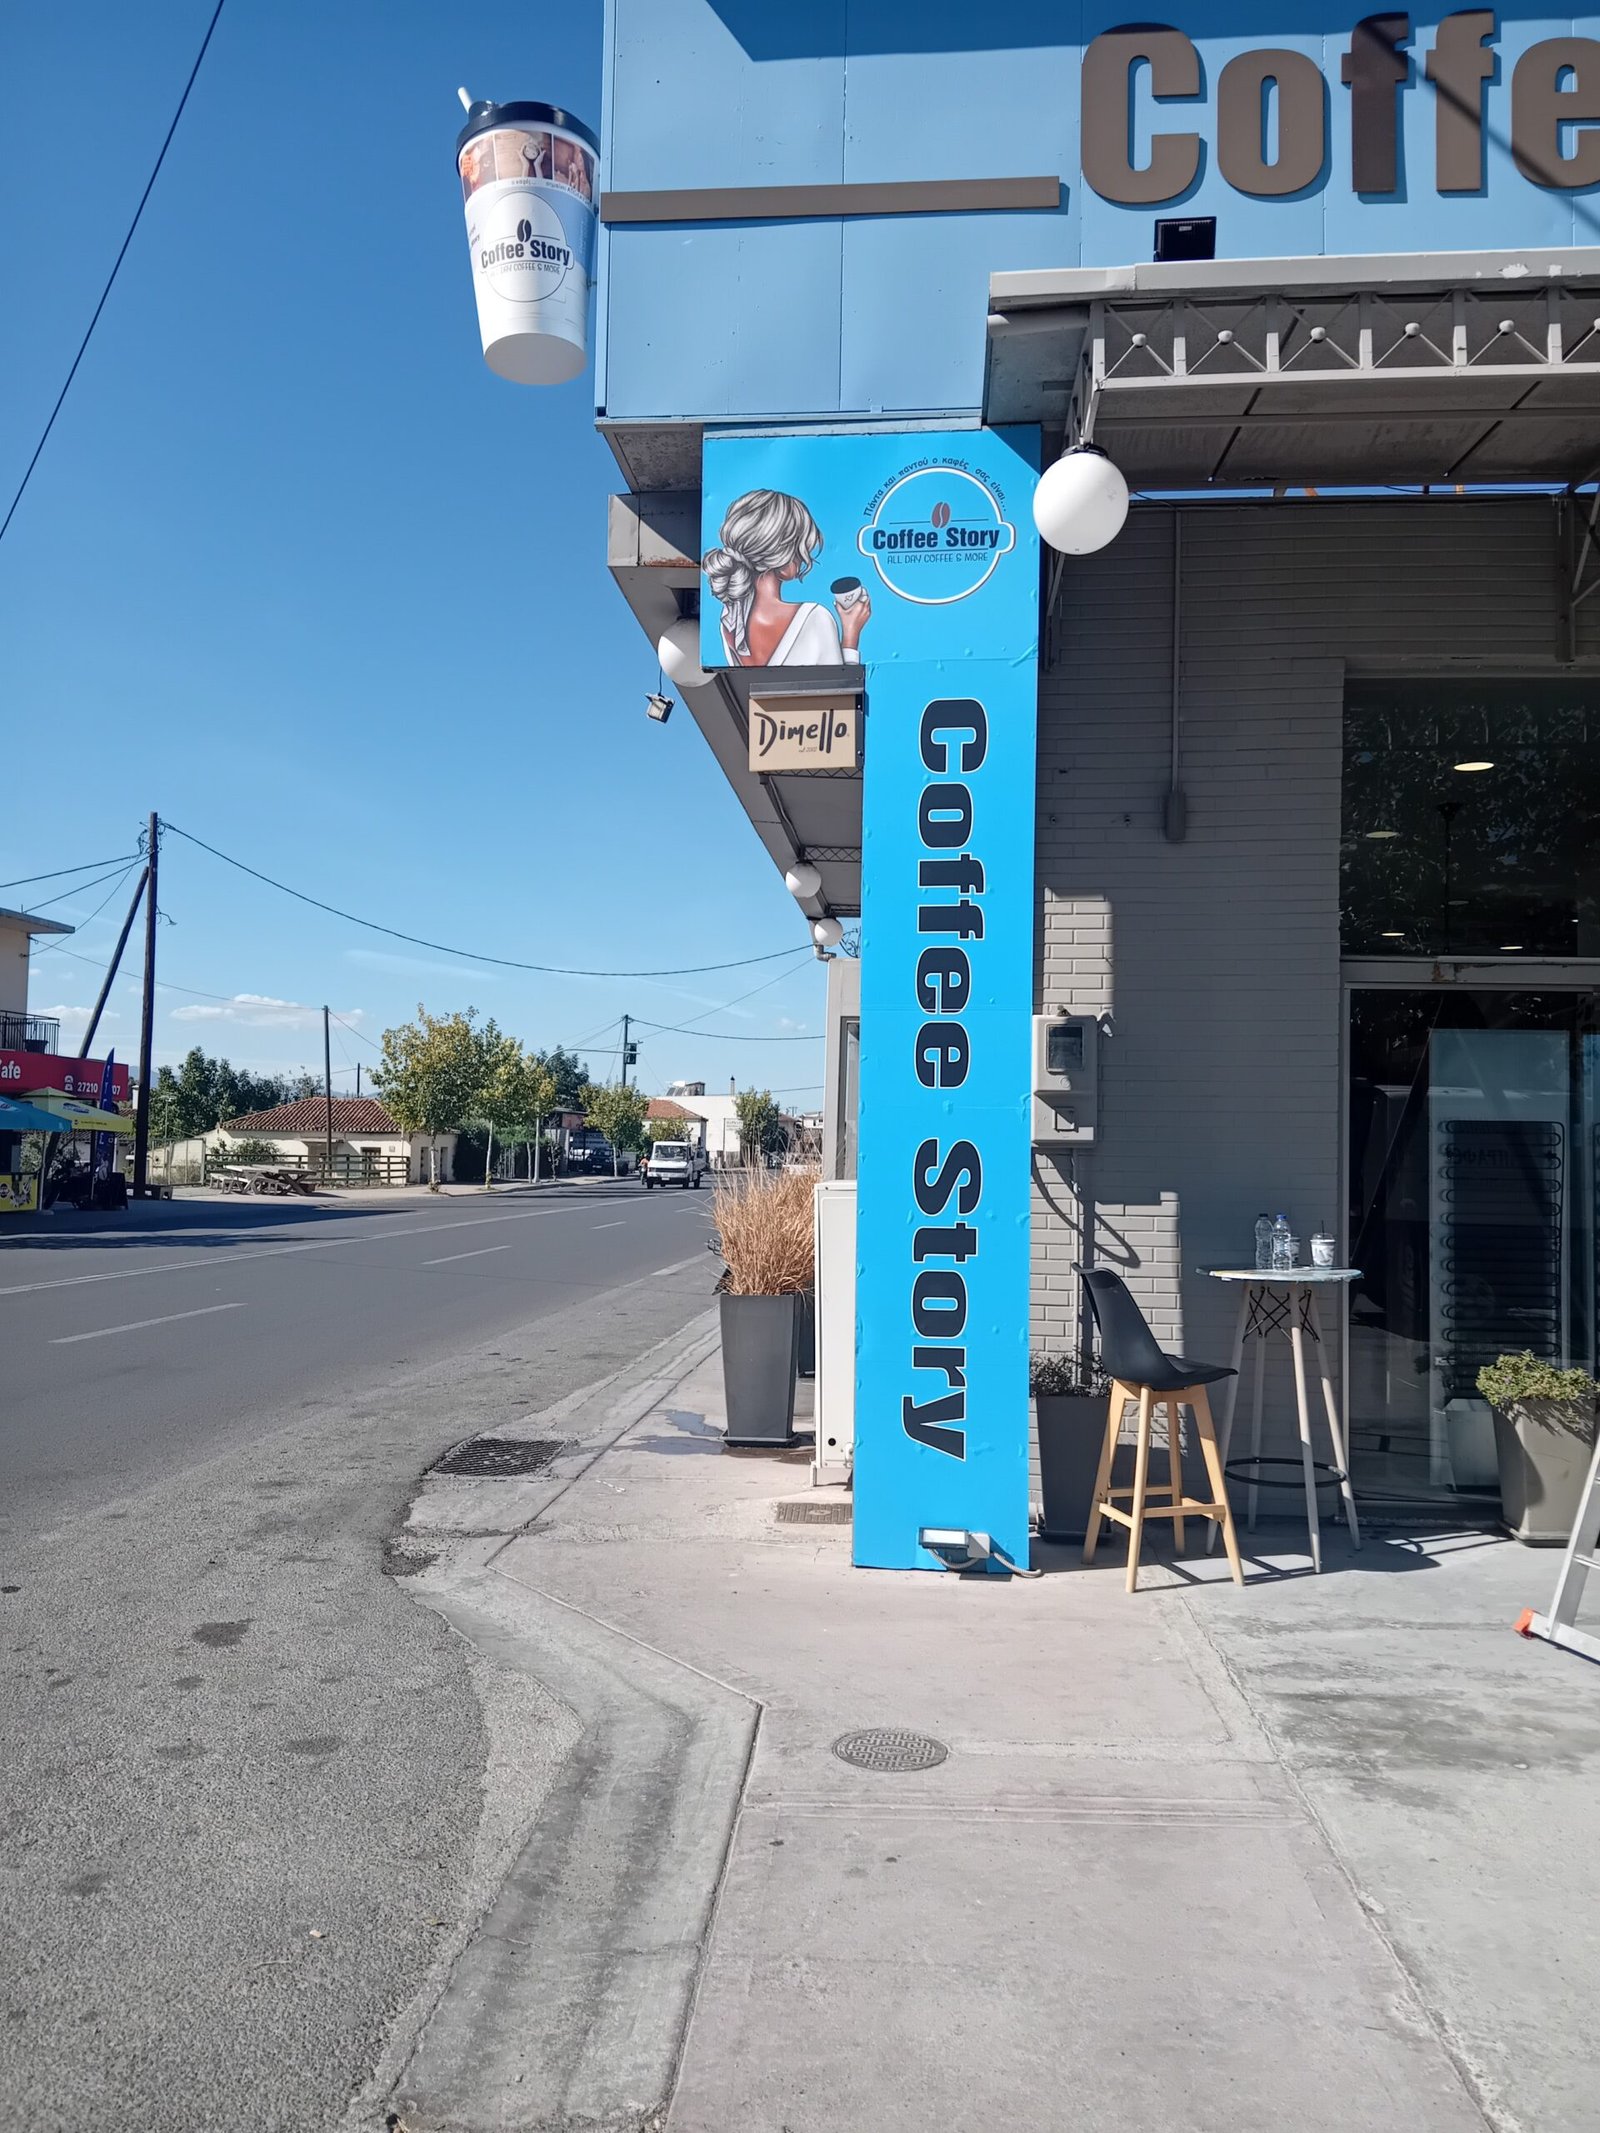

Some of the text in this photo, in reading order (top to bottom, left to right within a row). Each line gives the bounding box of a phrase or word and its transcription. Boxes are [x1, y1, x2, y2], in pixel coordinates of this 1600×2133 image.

[481, 240, 570, 269] Coffee Story
[863, 489, 884, 517] Πάντα
[884, 475, 897, 489] και
[898, 456, 929, 477] παντού
[942, 457, 970, 470] καφές
[975, 468, 991, 482] σας
[873, 527, 1000, 550] Coffee Story
[887, 555, 903, 565] ALL
[904, 554, 922, 564] DAY
[923, 553, 953, 563] COFFEE
[964, 552, 988, 562] MORE
[754, 709, 848, 757] Dimello
[0, 1059, 20, 1079] afe
[902, 698, 988, 1462] Coffee Story
[77, 1081, 99, 1094] 27210
